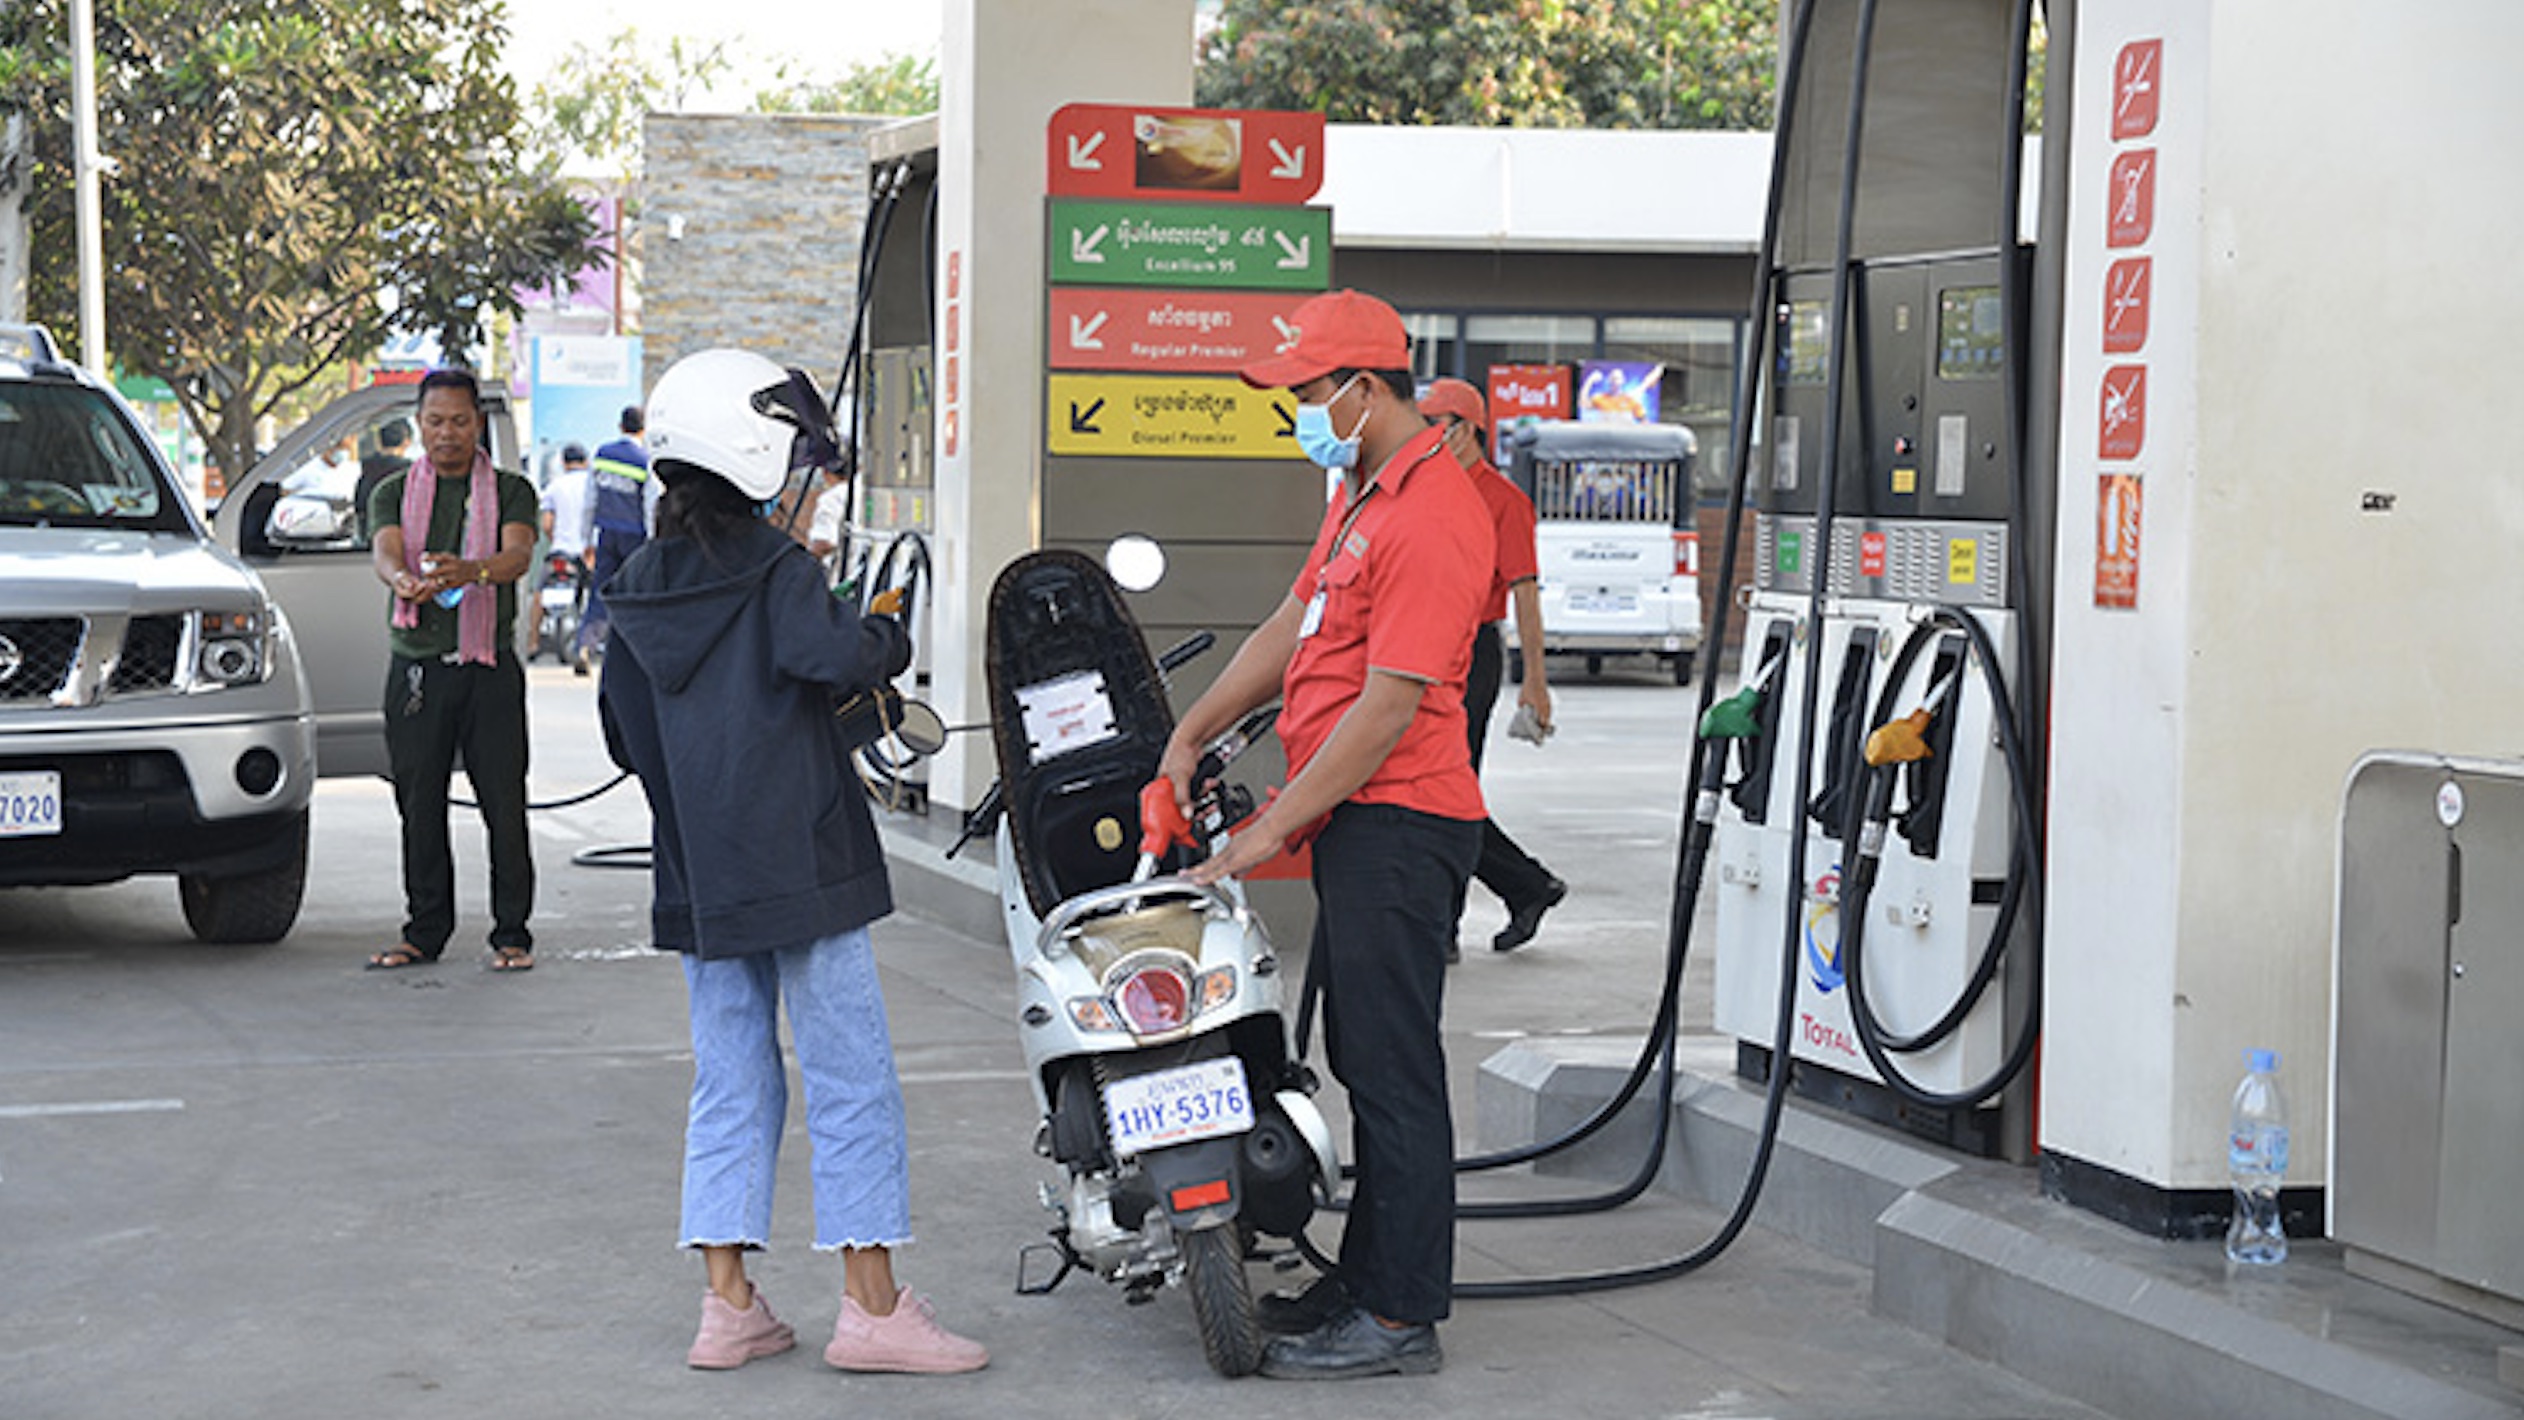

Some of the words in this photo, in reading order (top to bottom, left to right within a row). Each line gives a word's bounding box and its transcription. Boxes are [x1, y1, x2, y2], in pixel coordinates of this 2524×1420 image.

[1219, 258, 1237, 273] 95
[1131, 343, 1187, 359] Regular
[1190, 344, 1247, 357] Premier
[1132, 431, 1176, 444] Diesel
[1182, 432, 1236, 444] Premier
[1801, 1013, 1857, 1056] TOTAL
[1118, 1087, 1243, 1136] 1HY-5376
